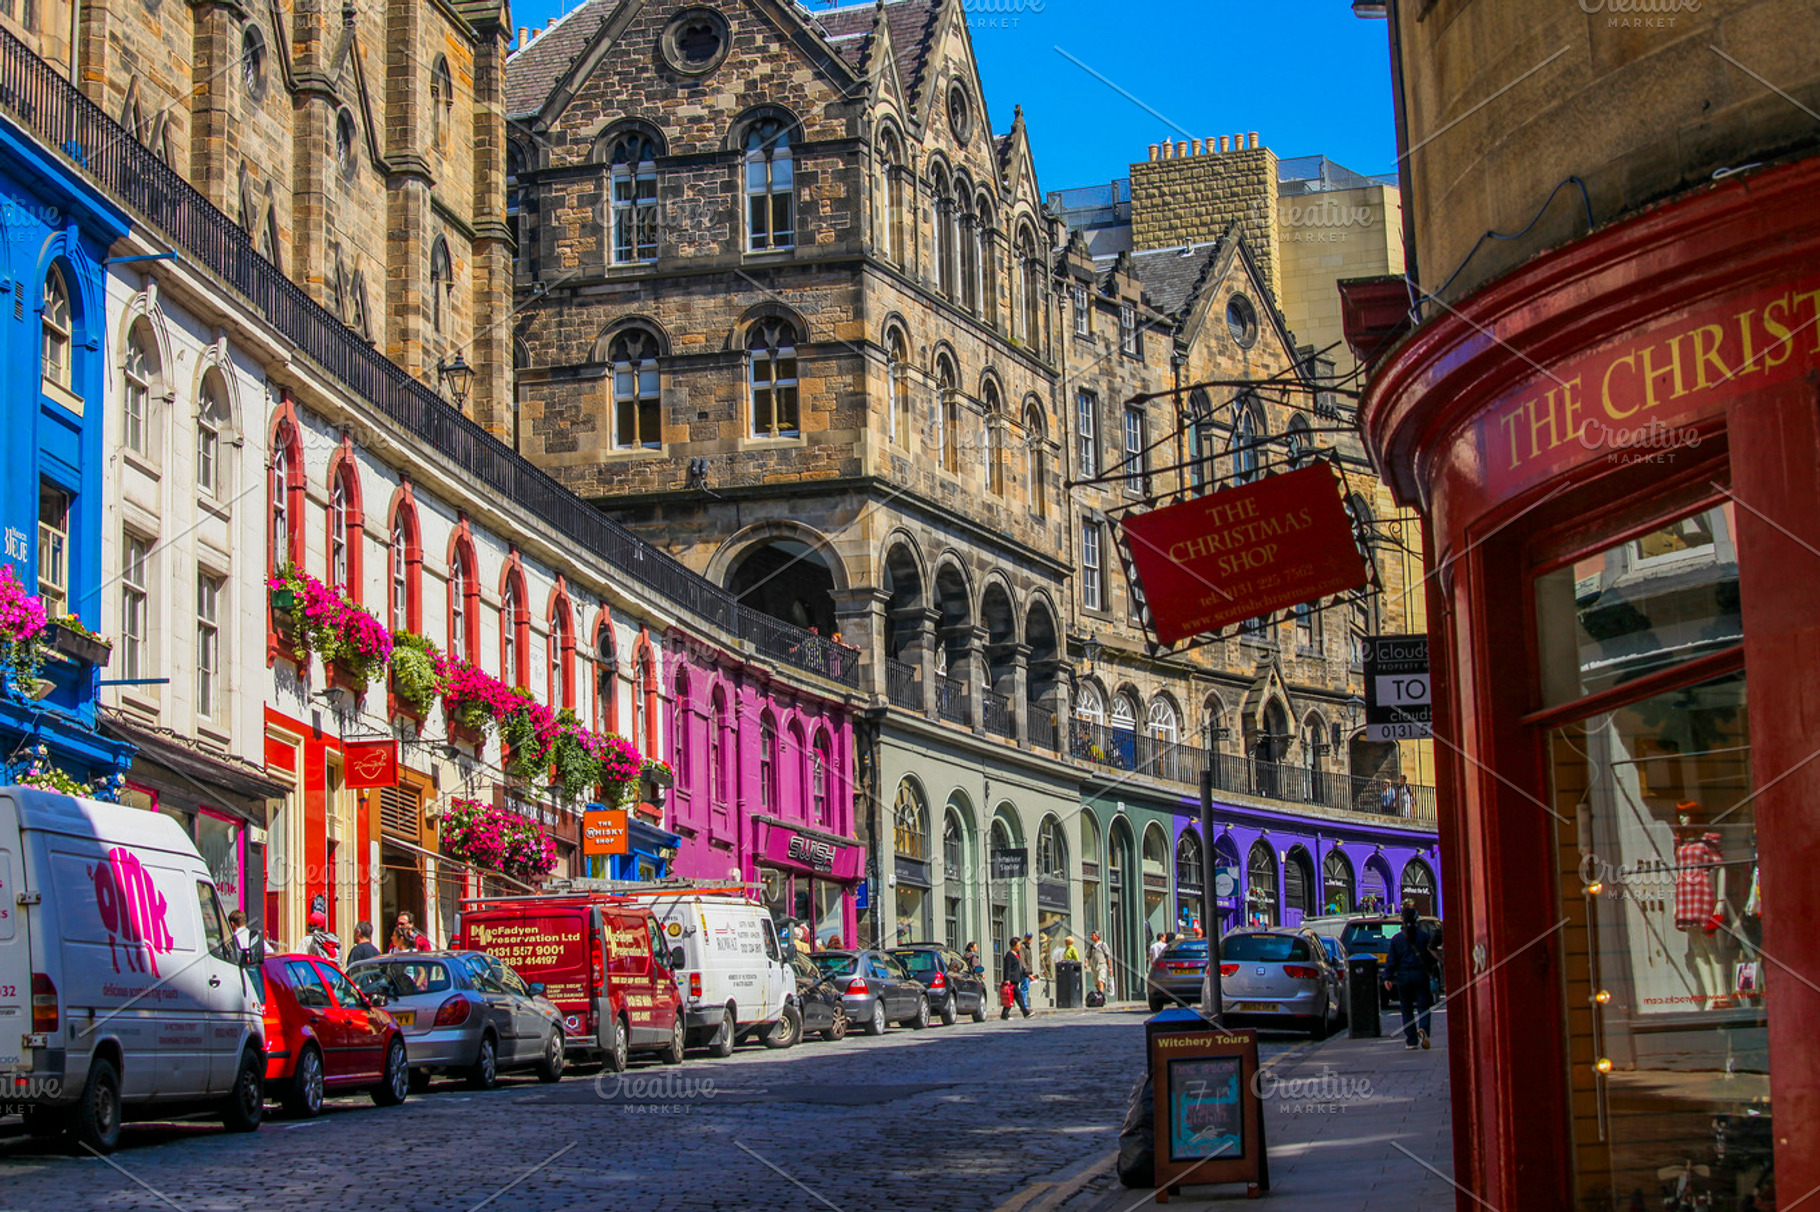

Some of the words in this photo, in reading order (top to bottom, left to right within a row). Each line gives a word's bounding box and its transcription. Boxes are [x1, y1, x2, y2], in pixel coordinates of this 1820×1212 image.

[1501, 372, 1583, 469] THE
[1205, 497, 1260, 527] THE
[1168, 507, 1313, 563] CHRISTMAS
[1217, 543, 1278, 578] SHOP
[1377, 663, 1418, 671] PROPERTY
[1392, 679, 1426, 700] TO
[1381, 726, 1412, 738] 0131
[585, 827, 624, 839] WHISKY
[471, 924, 539, 937] MacFadyen
[480, 933, 560, 946] Preservation
[561, 932, 581, 942] Ltd
[486, 946, 511, 957] 0131
[513, 945, 534, 956] 557
[535, 944, 565, 955] 9001
[525, 955, 558, 965] 414197
[1157, 1036, 1213, 1048] Witchery
[1214, 1034, 1250, 1045] Tours
